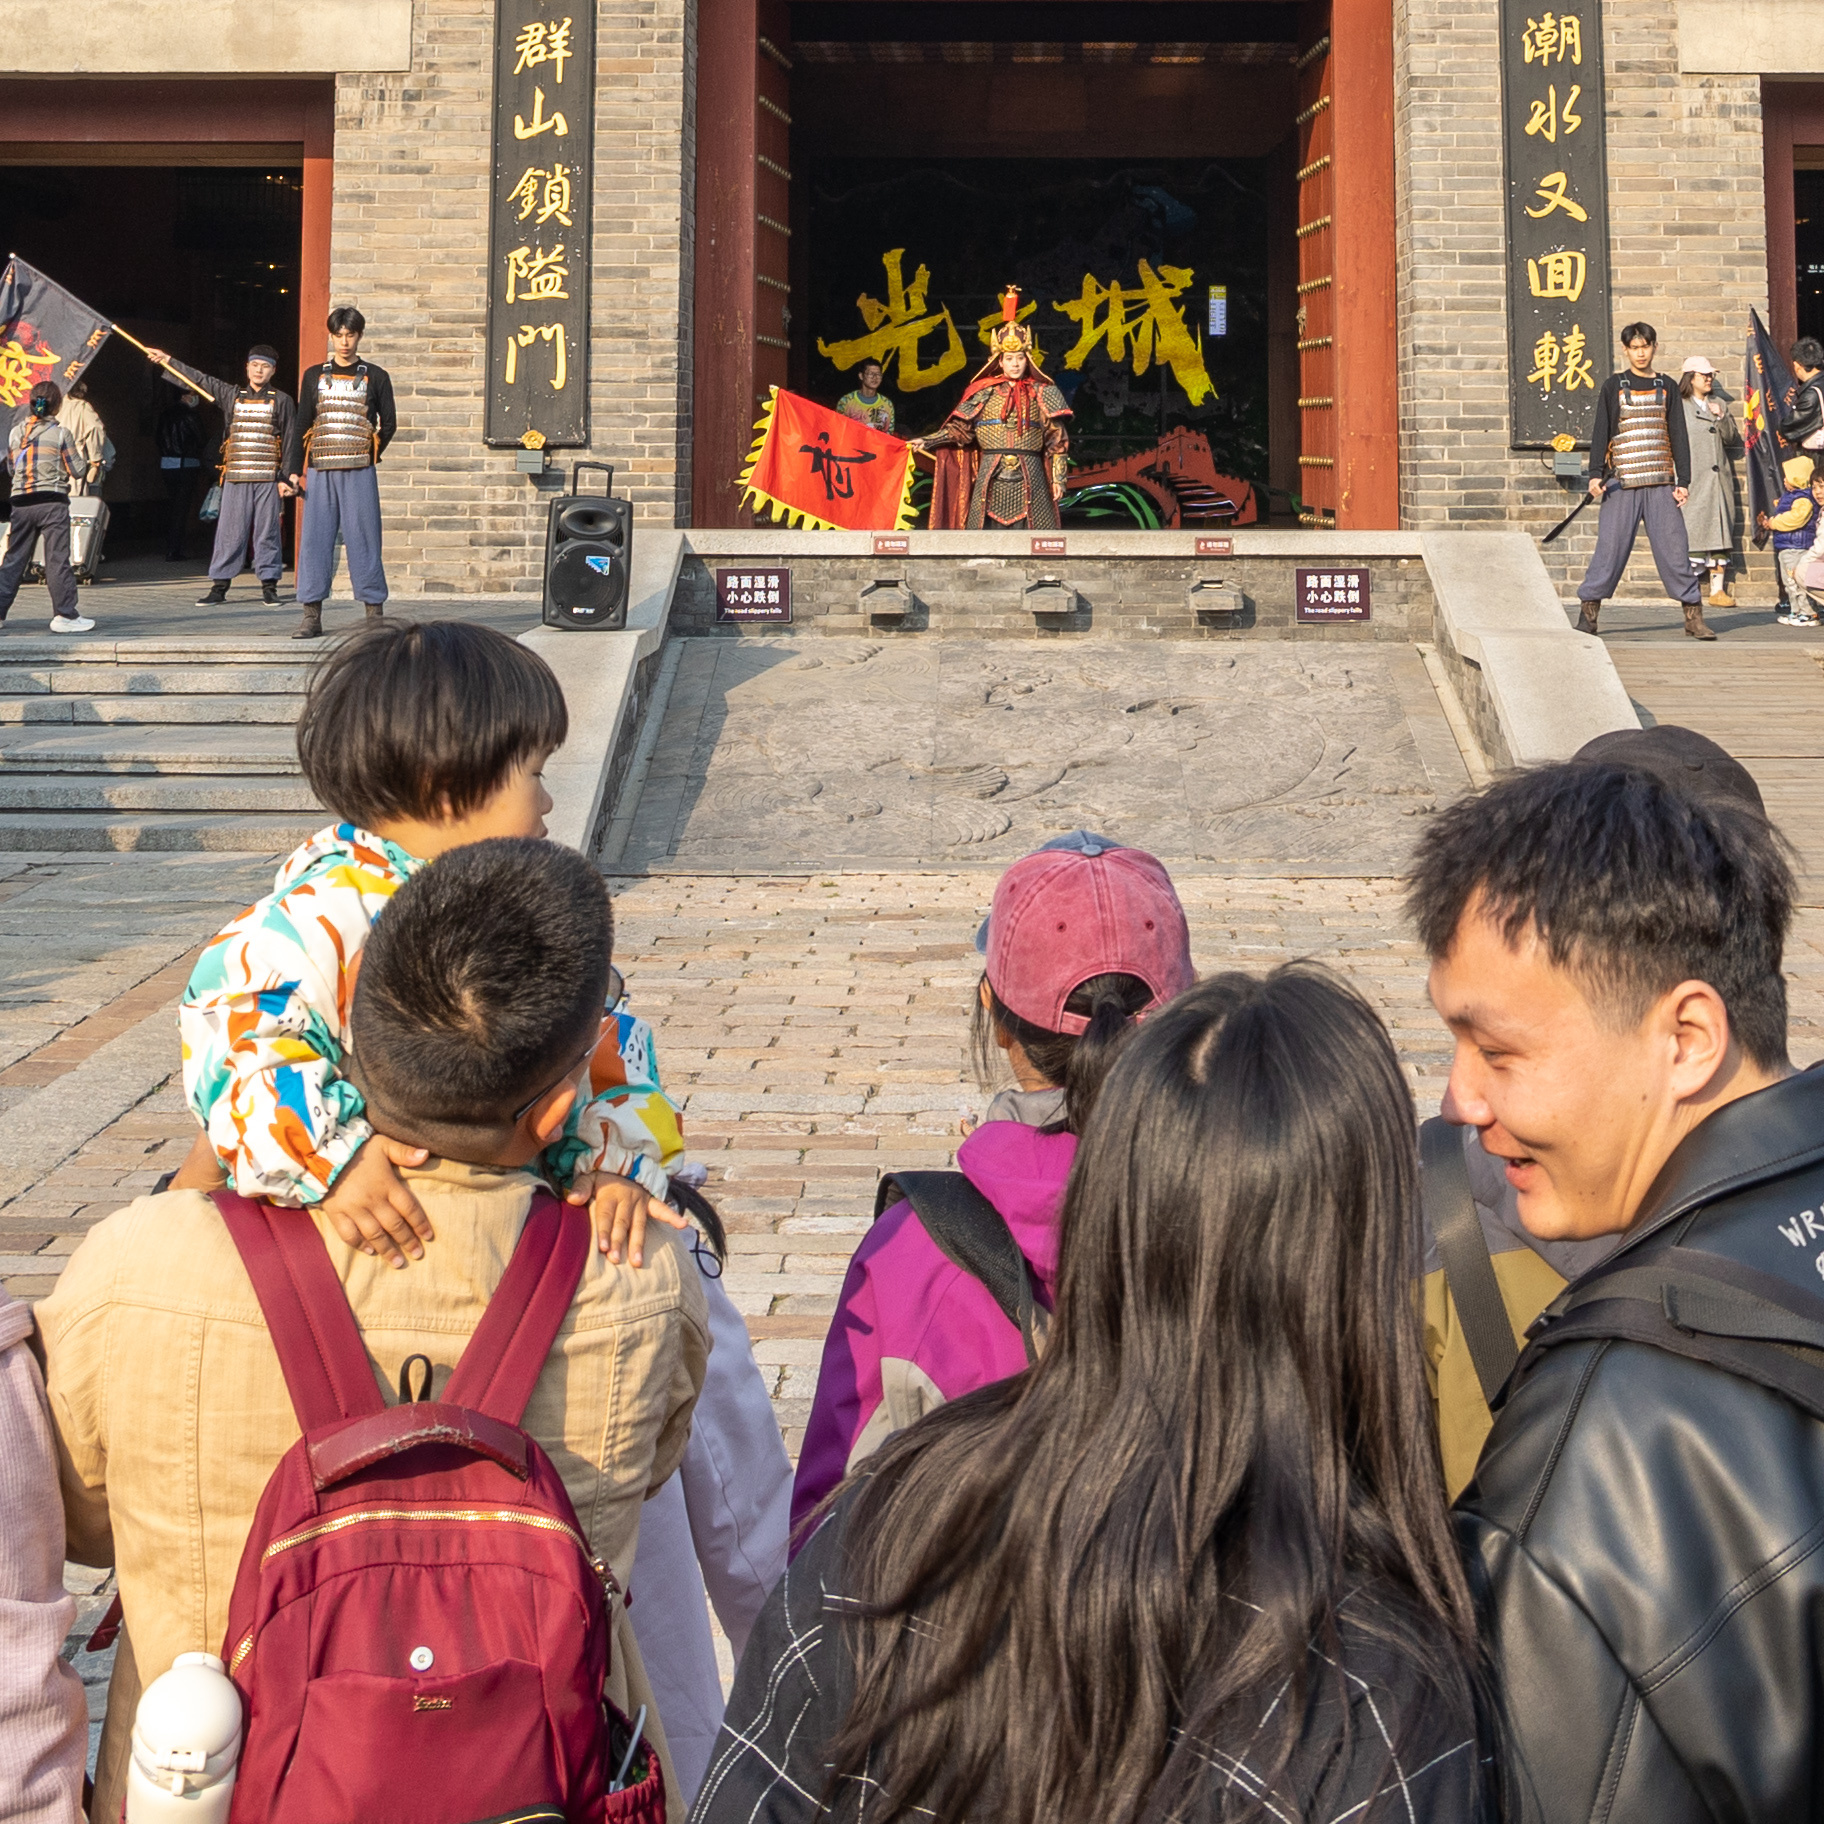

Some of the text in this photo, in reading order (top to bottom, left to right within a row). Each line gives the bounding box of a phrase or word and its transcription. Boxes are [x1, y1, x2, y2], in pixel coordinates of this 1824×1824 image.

[726, 575, 780, 589] 路面湿滑
[1306, 574, 1360, 588] 路面湿滑
[726, 590, 780, 604] 小心跌倒
[1306, 590, 1360, 604] 小心跌倒
